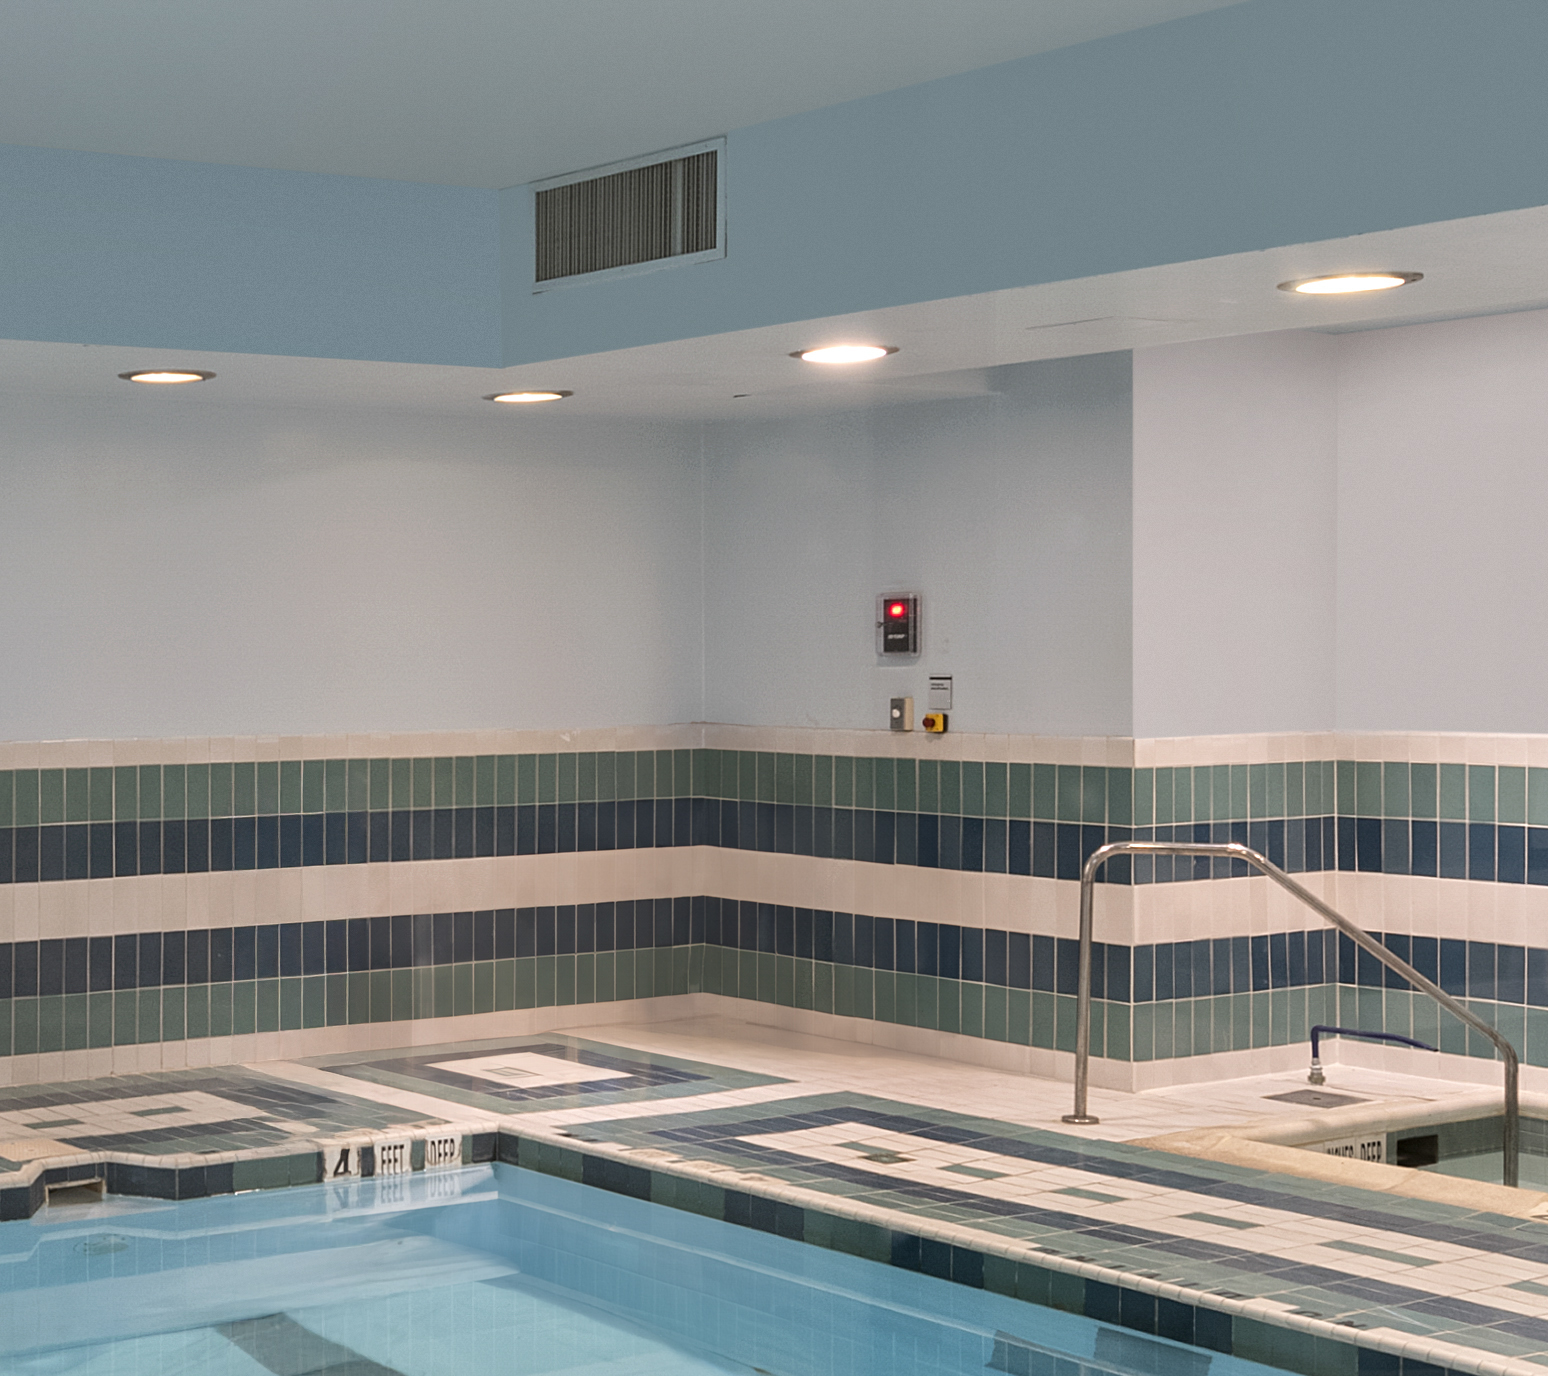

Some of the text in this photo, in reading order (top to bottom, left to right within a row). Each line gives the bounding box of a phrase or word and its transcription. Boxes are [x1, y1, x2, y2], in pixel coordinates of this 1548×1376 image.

[334, 1138, 455, 1177] 4 FEET DEEP
